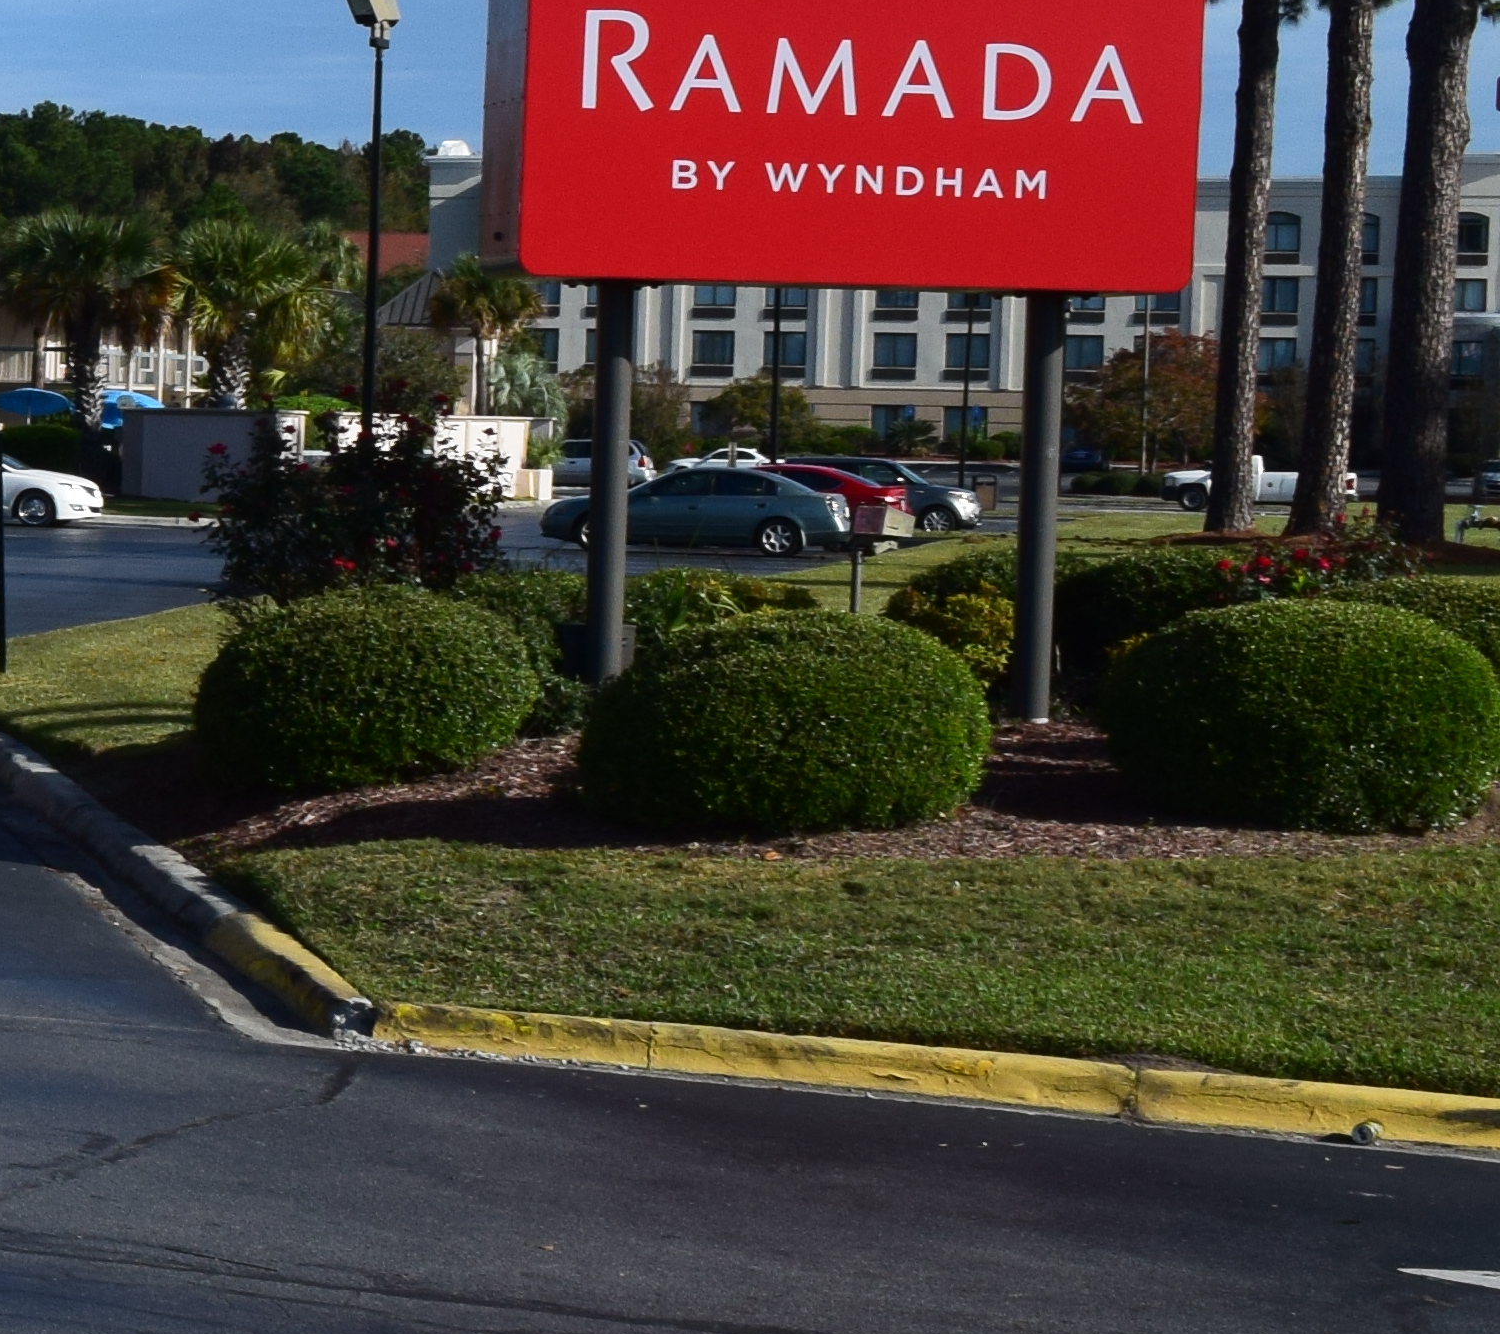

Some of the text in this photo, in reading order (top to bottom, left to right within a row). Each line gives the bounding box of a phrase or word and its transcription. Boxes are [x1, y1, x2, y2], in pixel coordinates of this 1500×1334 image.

[581, 9, 1143, 124] RAMADA
[671, 159, 1047, 199] BY WYNDHAM
